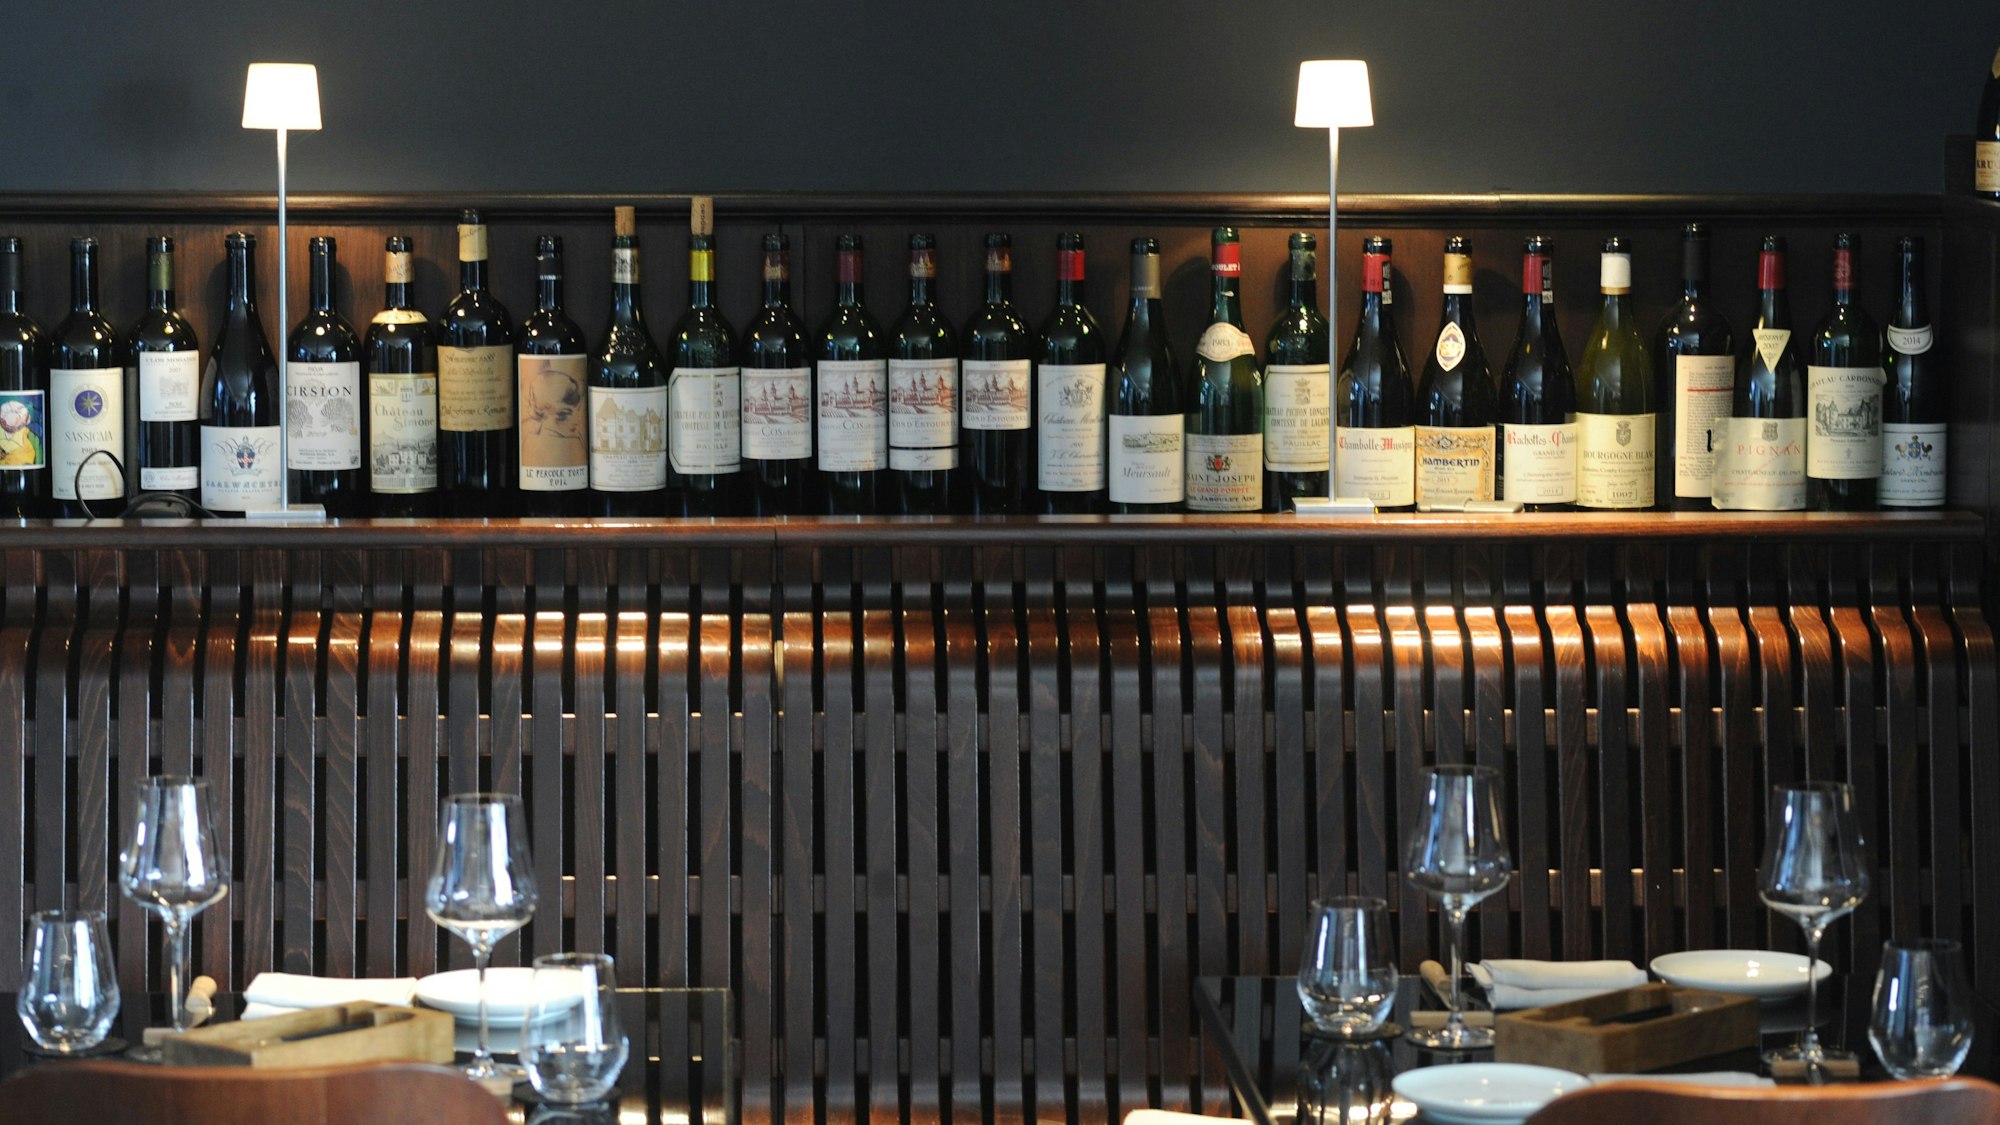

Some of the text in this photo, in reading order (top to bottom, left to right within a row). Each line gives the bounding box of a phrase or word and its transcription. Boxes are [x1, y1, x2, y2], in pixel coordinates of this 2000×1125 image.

[1902, 336, 1921, 346] 2014
[287, 384, 353, 399] CIRSION
[64, 431, 113, 441] SASSICAIA
[1583, 450, 1634, 460] BOURGOGNE
[1737, 444, 1801, 457] PIGNAN
[1123, 466, 1171, 478] Meursault
